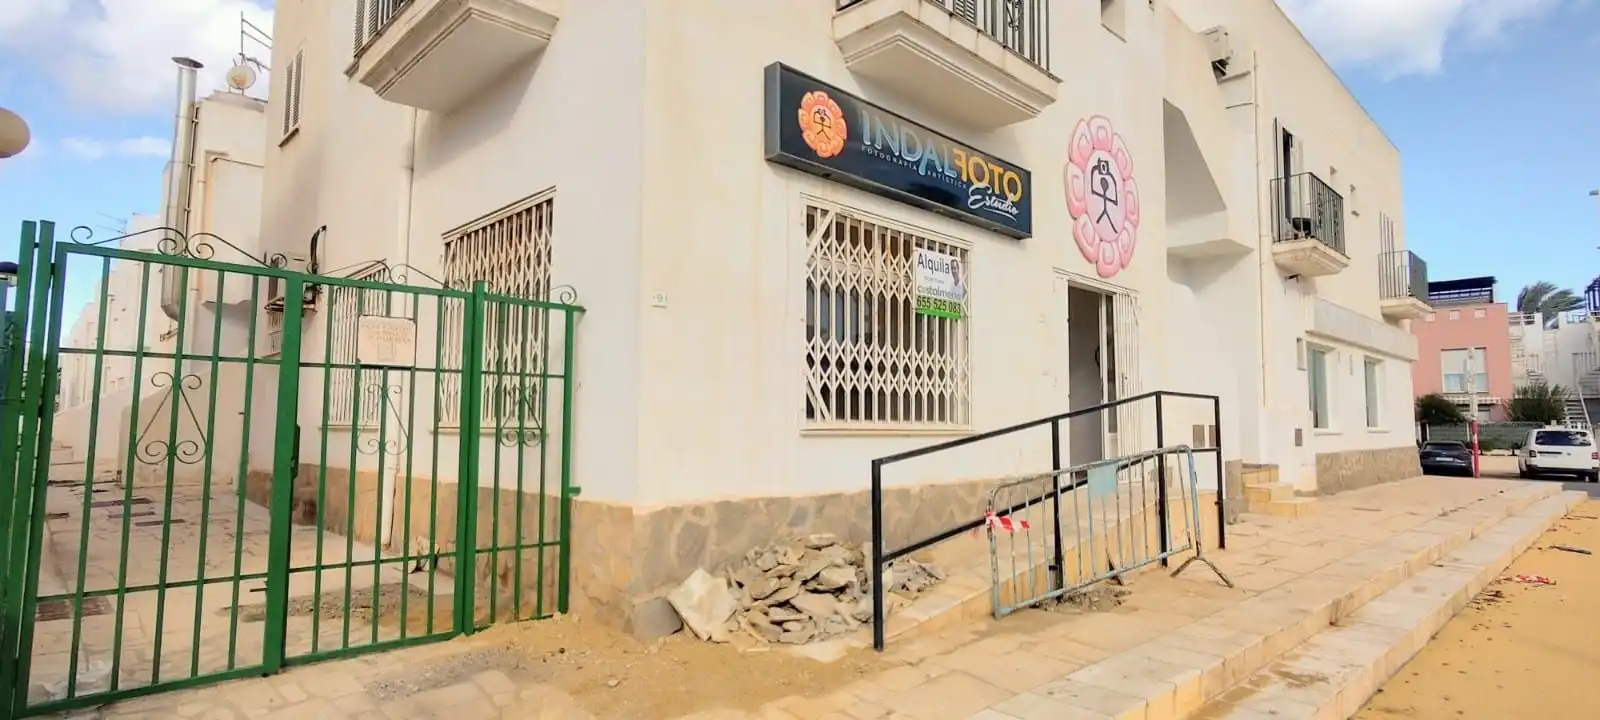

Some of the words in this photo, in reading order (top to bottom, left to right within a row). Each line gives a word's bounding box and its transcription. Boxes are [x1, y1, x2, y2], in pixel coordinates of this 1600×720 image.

[967, 184, 1020, 217] Estudio
[917, 252, 950, 275] Alquila
[917, 295, 931, 309] 655
[933, 298, 947, 312] 525
[949, 301, 961, 315] 083
